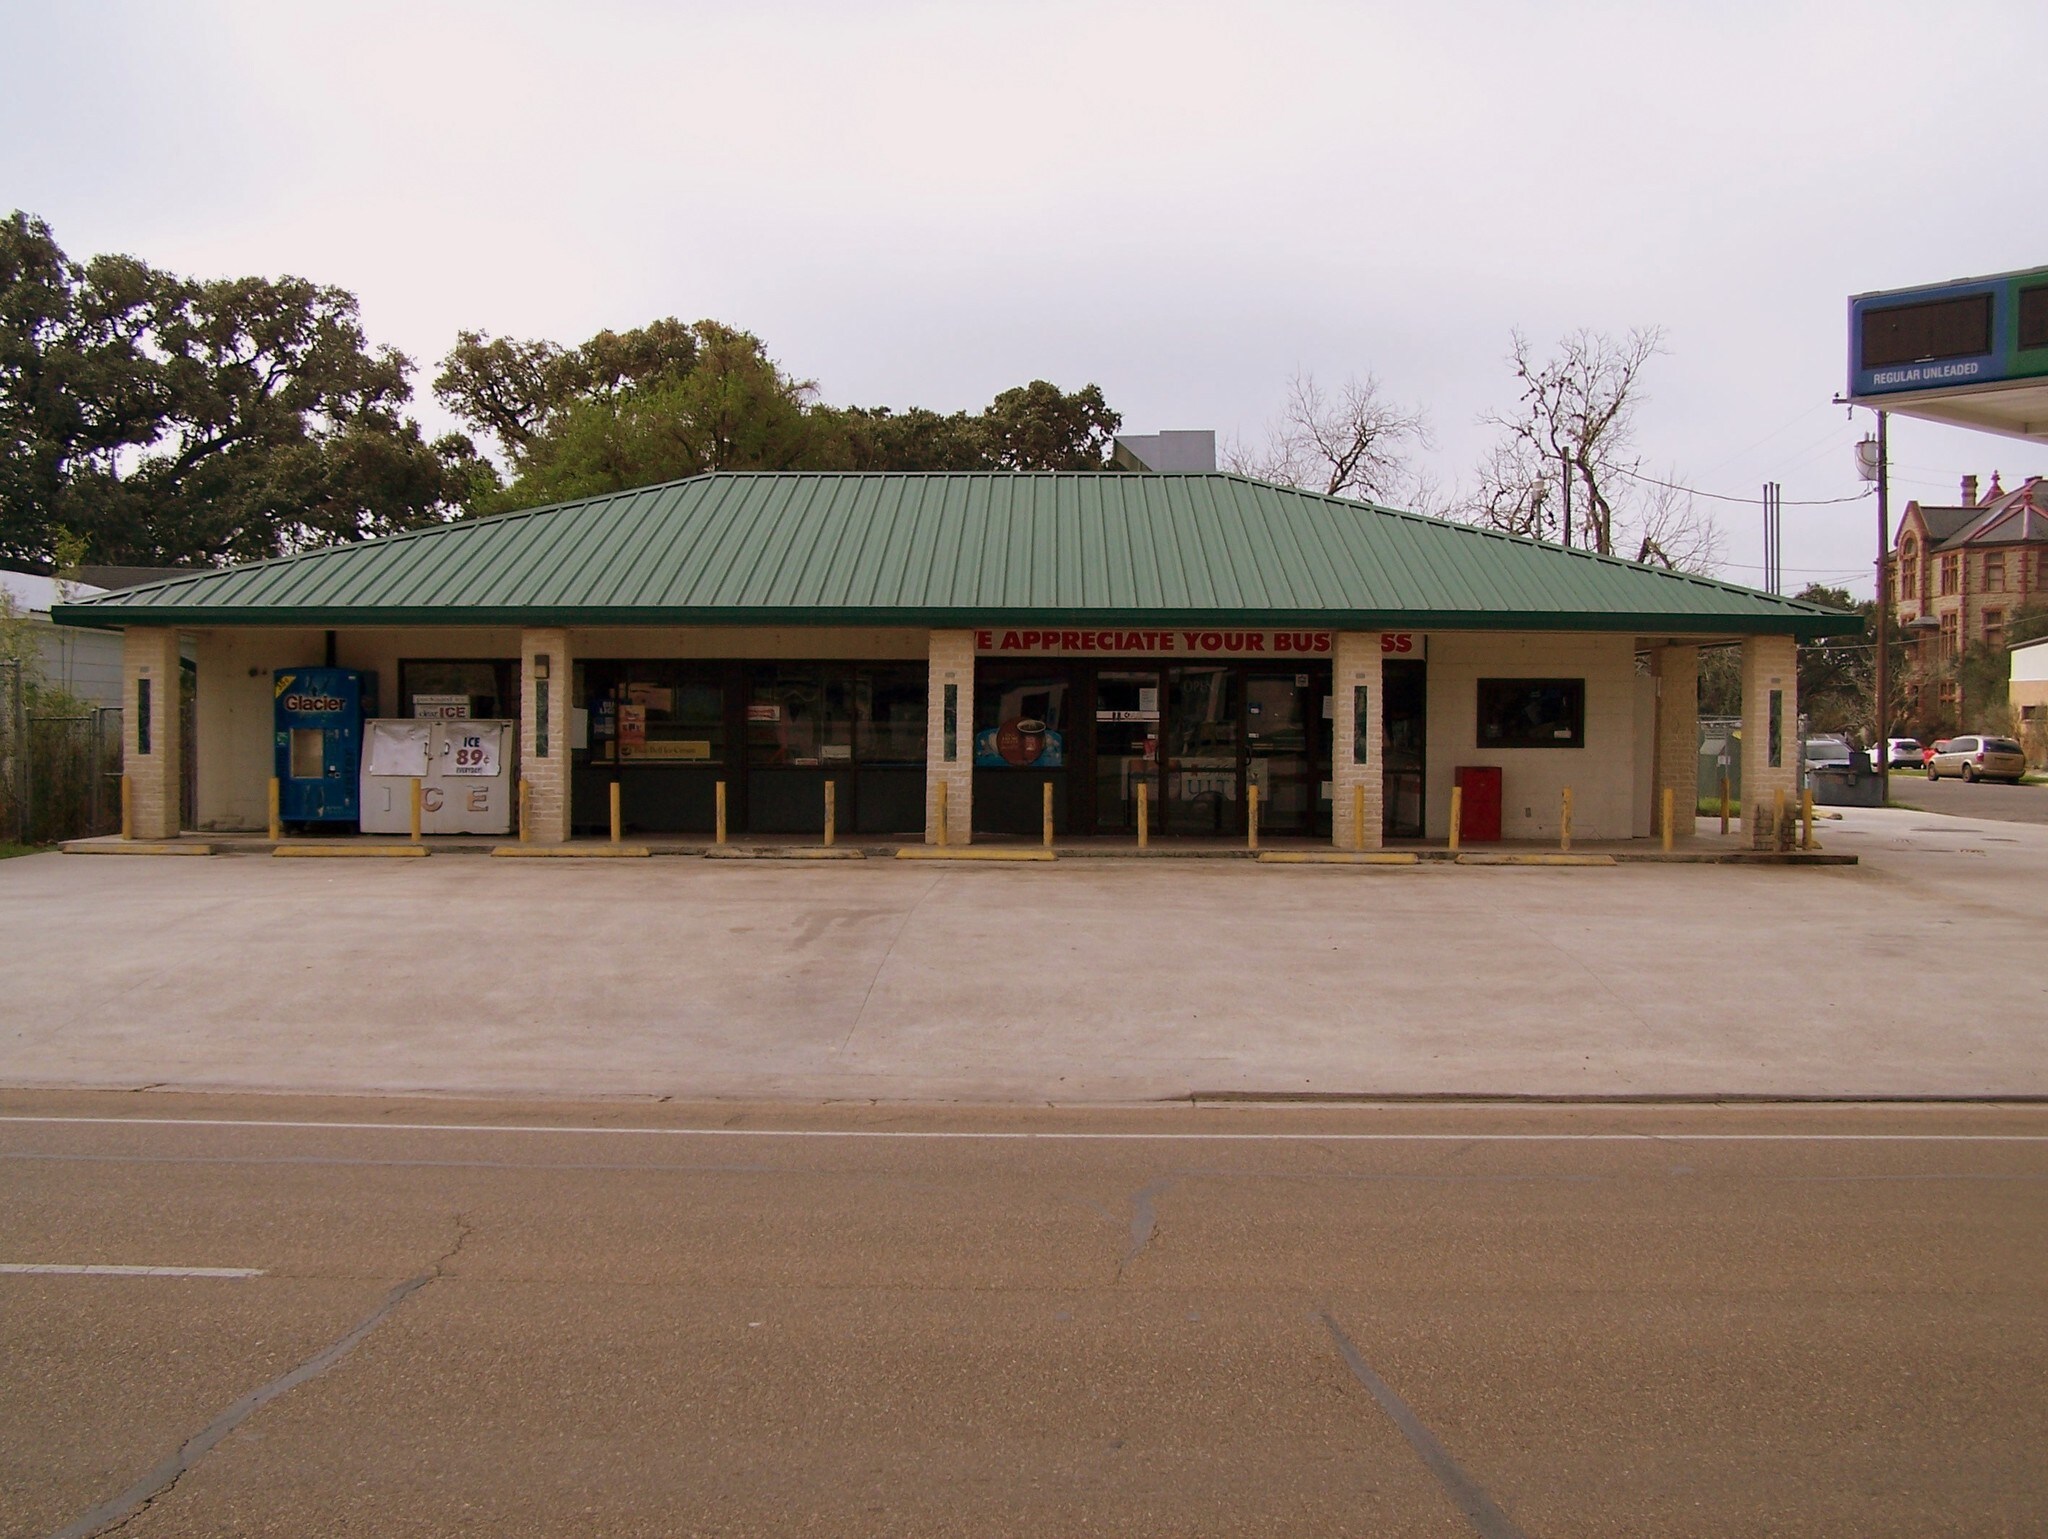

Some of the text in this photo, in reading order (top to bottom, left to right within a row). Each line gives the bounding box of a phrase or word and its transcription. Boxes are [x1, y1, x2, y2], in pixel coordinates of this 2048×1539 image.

[1873, 362, 1979, 385] REGULAR UNLEADED
[974, 631, 993, 650] E
[999, 631, 1174, 651] APPRECIATE
[1182, 632, 1265, 652] YOUR
[284, 693, 347, 712] Glacier
[439, 706, 466, 718] ICE
[463, 736, 480, 748] ICE
[456, 749, 490, 766] 89¢
[381, 785, 489, 812] ICE
